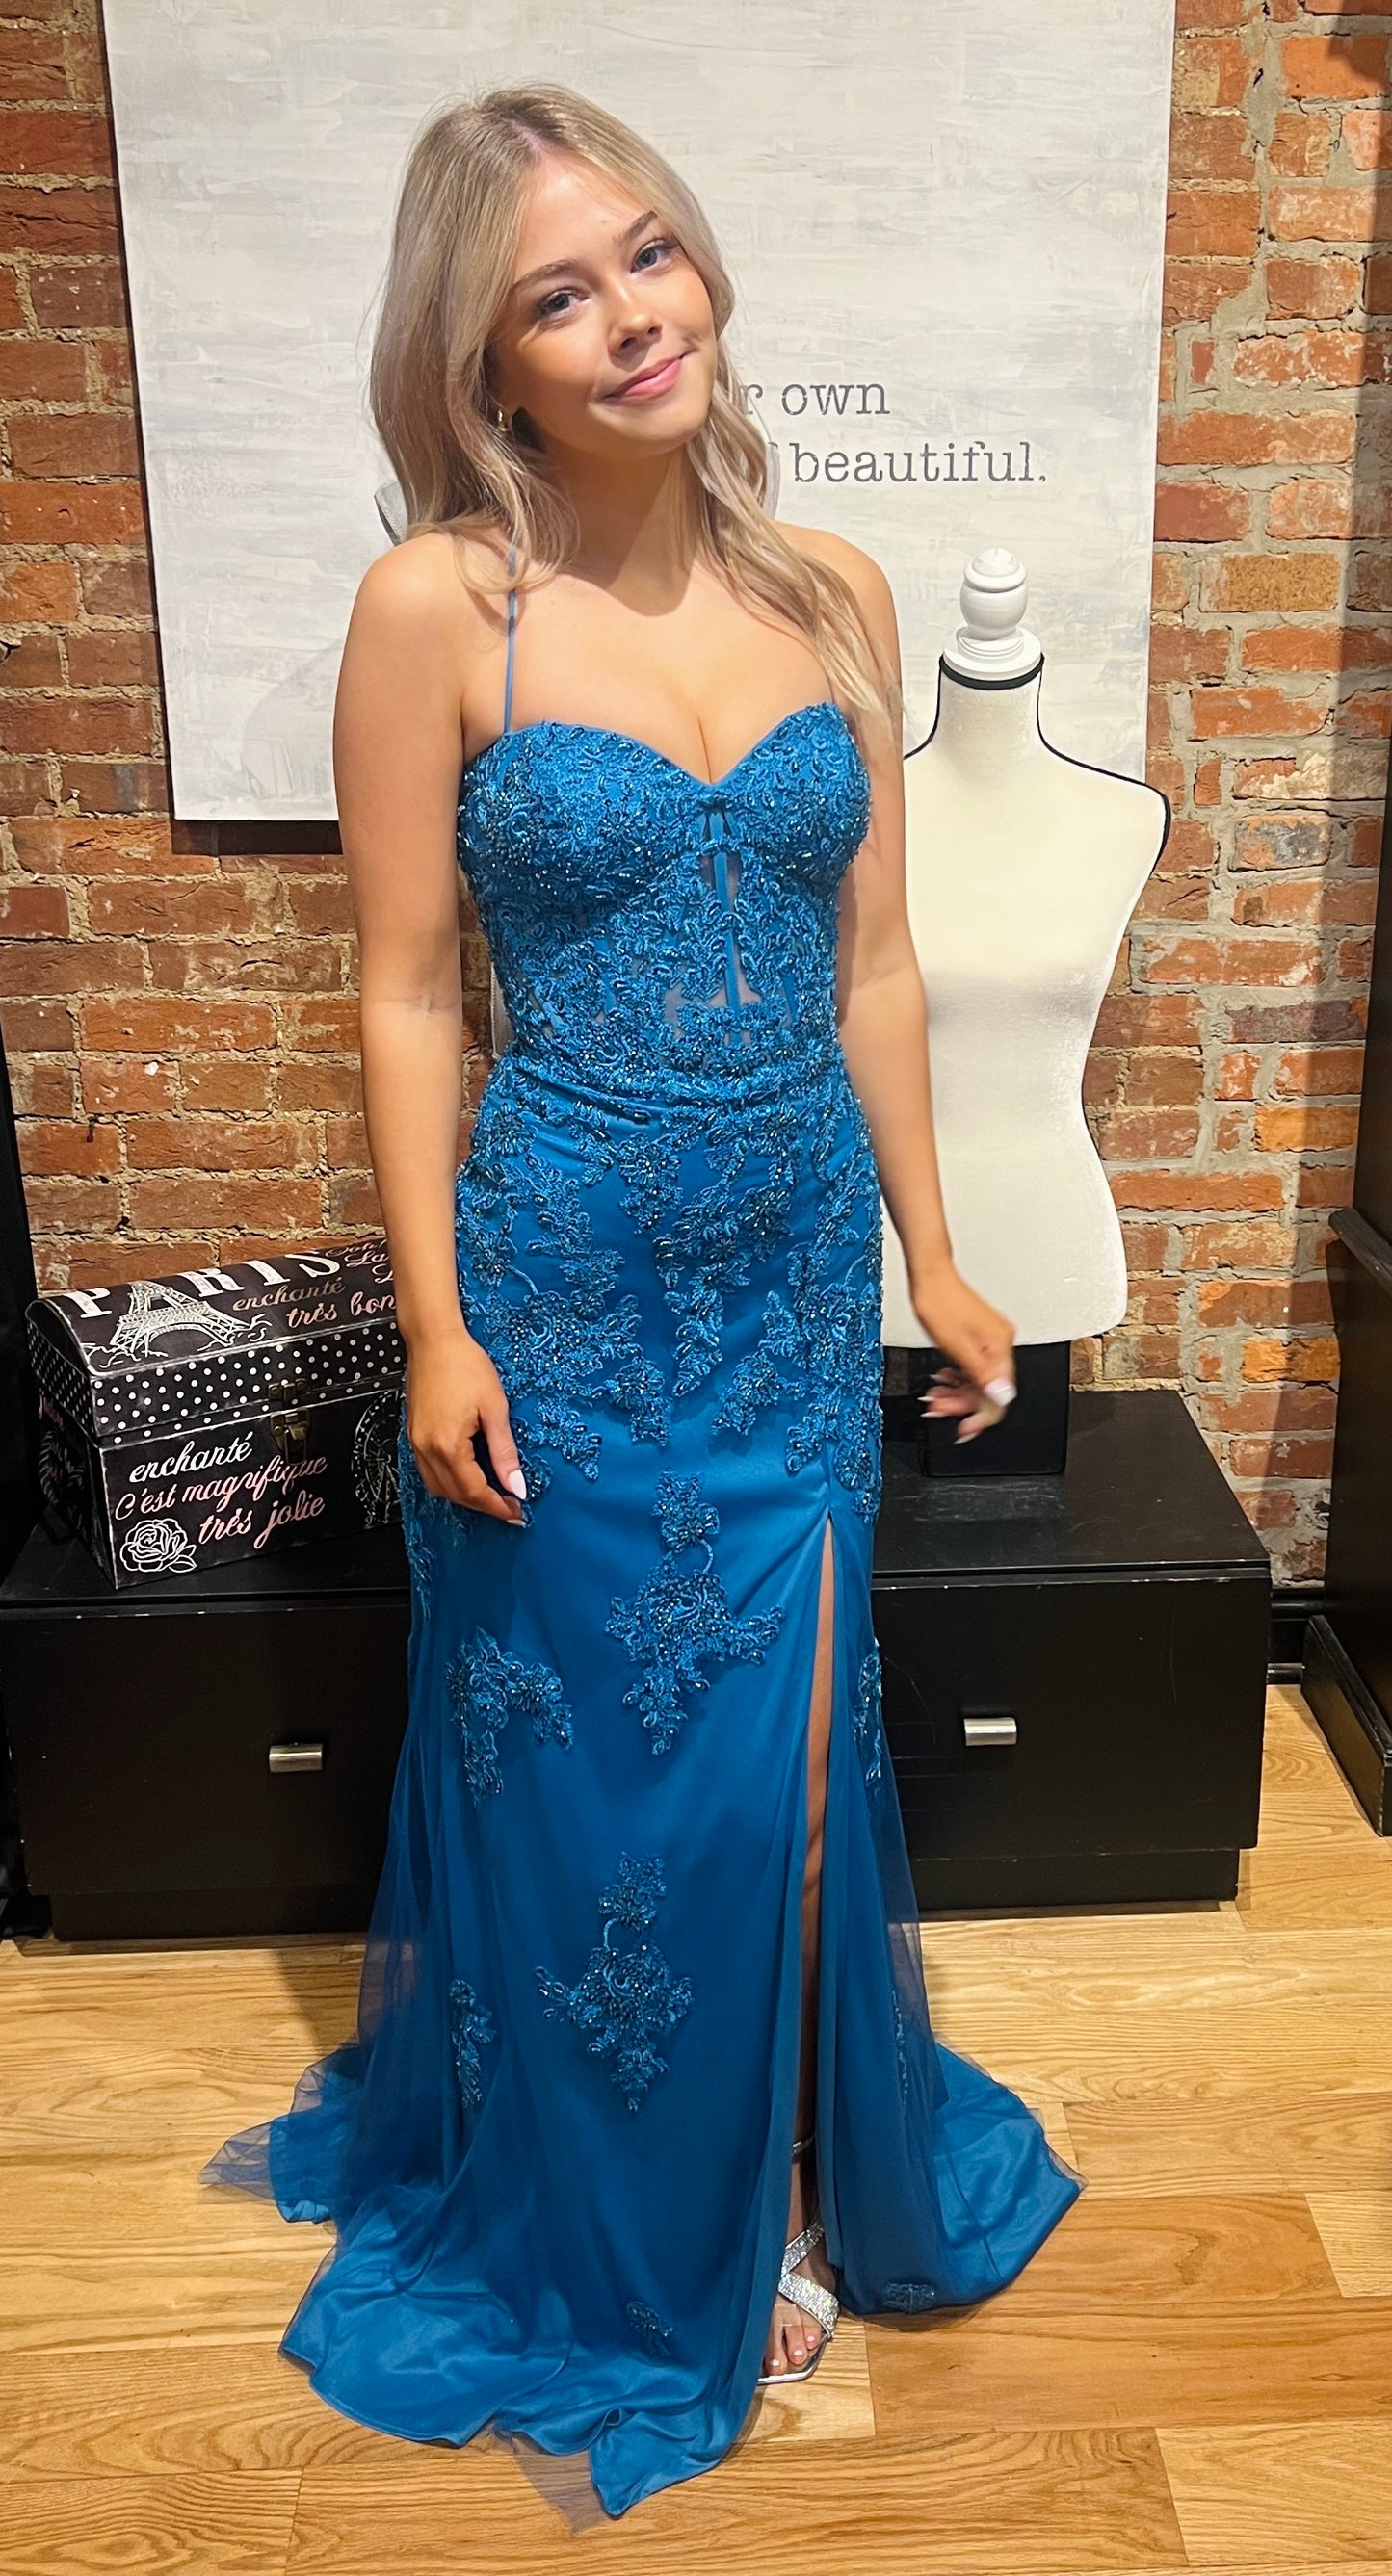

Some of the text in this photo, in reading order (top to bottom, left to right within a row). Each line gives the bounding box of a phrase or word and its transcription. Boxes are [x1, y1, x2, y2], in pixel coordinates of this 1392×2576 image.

[780, 383, 891, 416] own
[788, 440, 1046, 483] beautiful.
[232, 1276, 346, 1313] enchanté
[129, 1431, 254, 1483] enchanté
[115, 1454, 328, 1521] C'est magnifique
[253, 1489, 326, 1550] jolie
